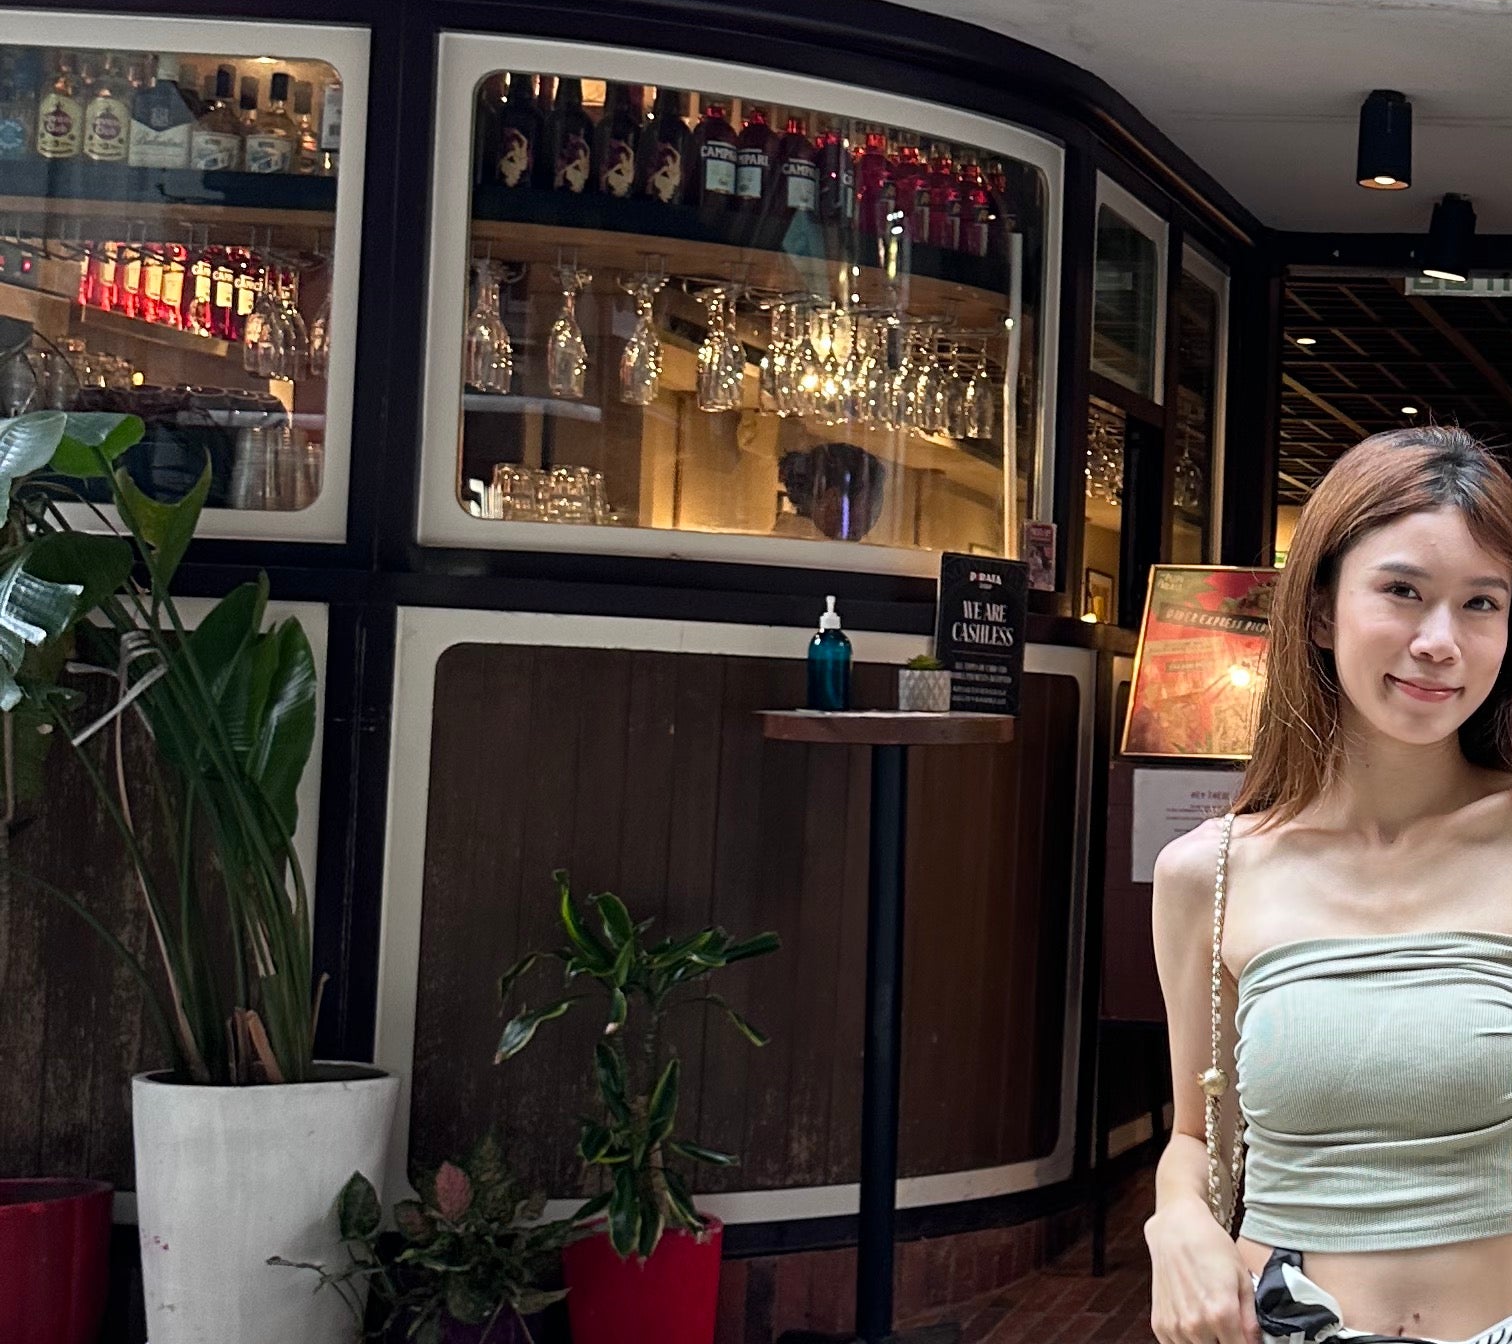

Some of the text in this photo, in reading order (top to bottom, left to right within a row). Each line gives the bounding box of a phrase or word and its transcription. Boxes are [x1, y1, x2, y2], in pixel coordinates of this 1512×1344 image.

[962, 600, 1008, 623] WE ARE
[951, 622, 1015, 647] CASHLESS
